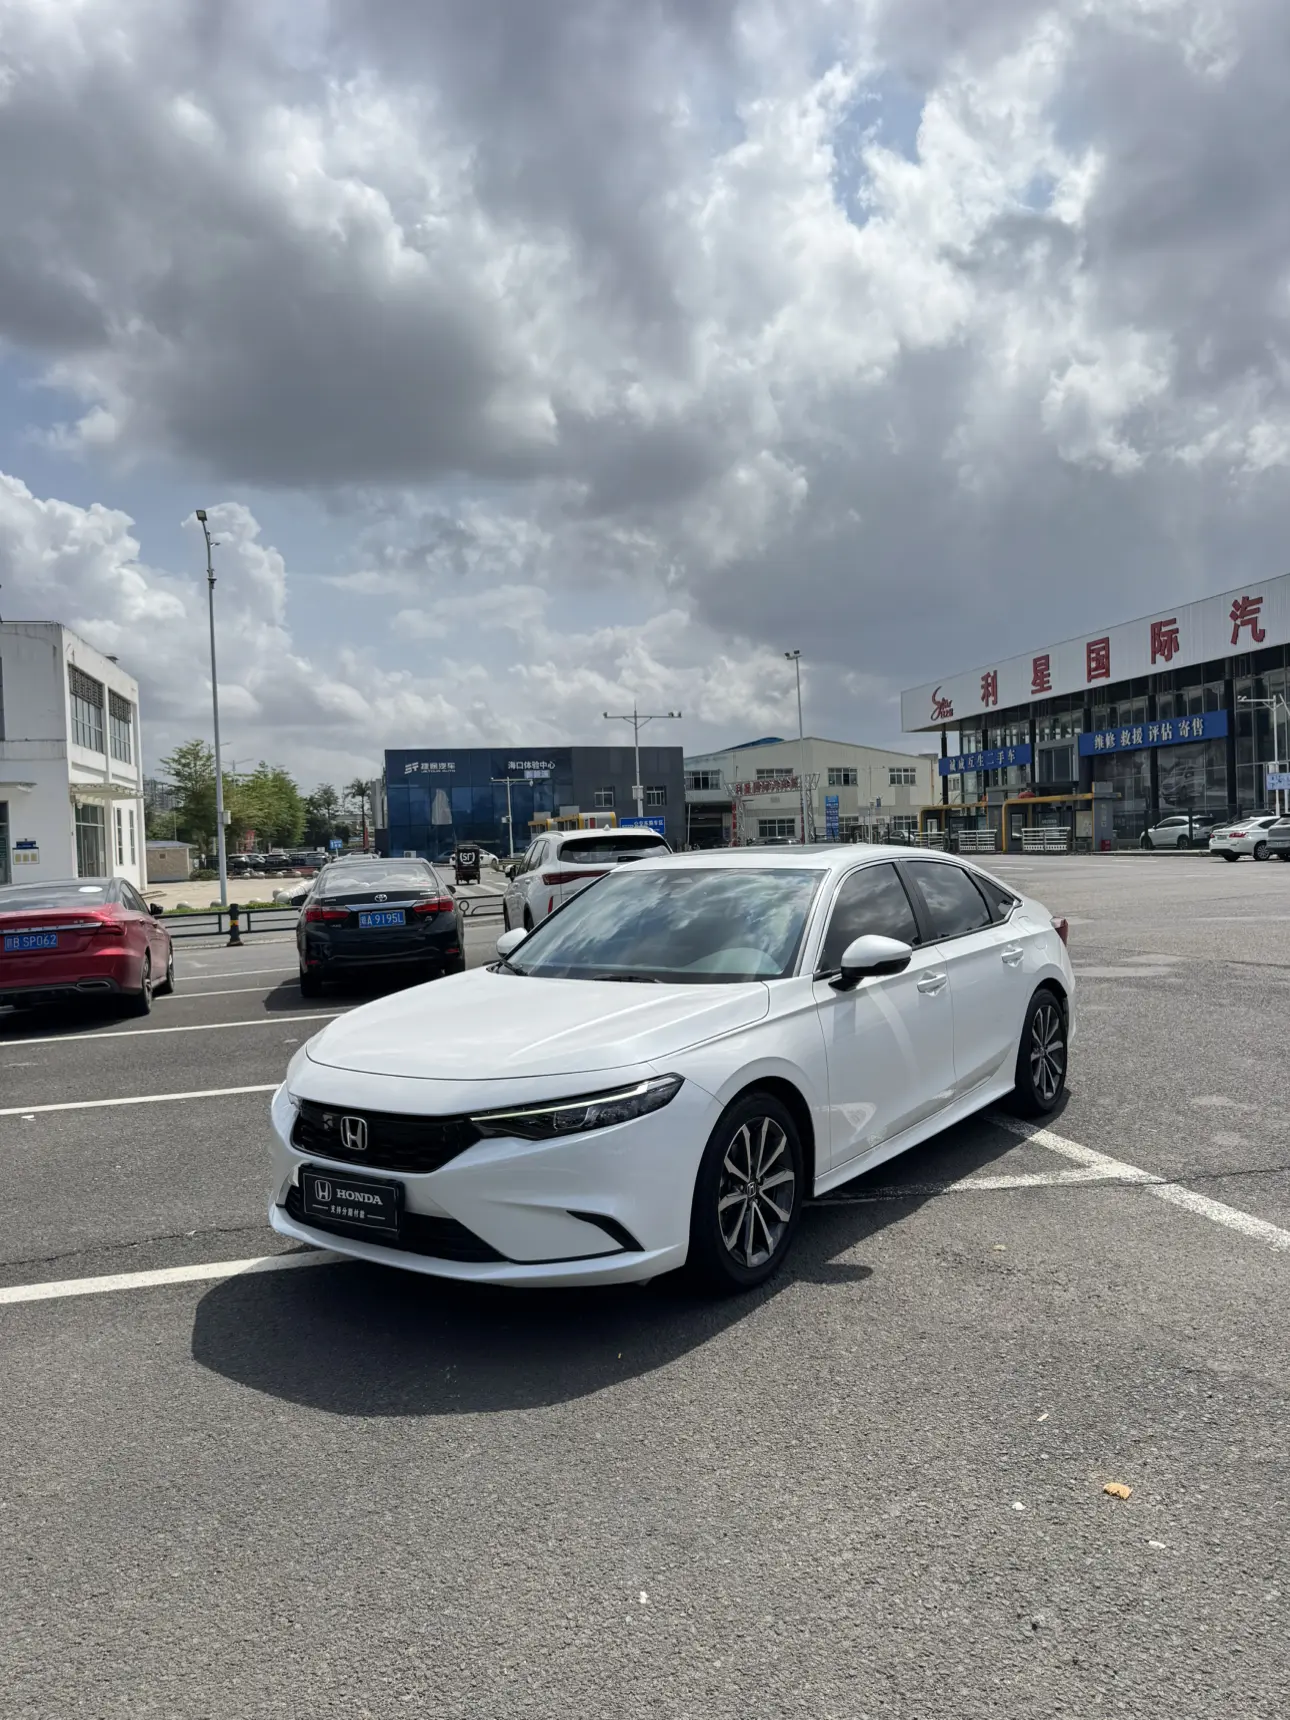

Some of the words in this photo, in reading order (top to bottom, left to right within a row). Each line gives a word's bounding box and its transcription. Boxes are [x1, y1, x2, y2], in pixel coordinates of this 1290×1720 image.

[980, 596, 1266, 707] 利星国际汽
[1120, 727, 1143, 747] 救援
[1148, 722, 1172, 742] 评估
[1178, 717, 1204, 737] 寄售
[508, 760, 555, 770] 海口体验中心
[336, 1188, 383, 1206] HONDA
